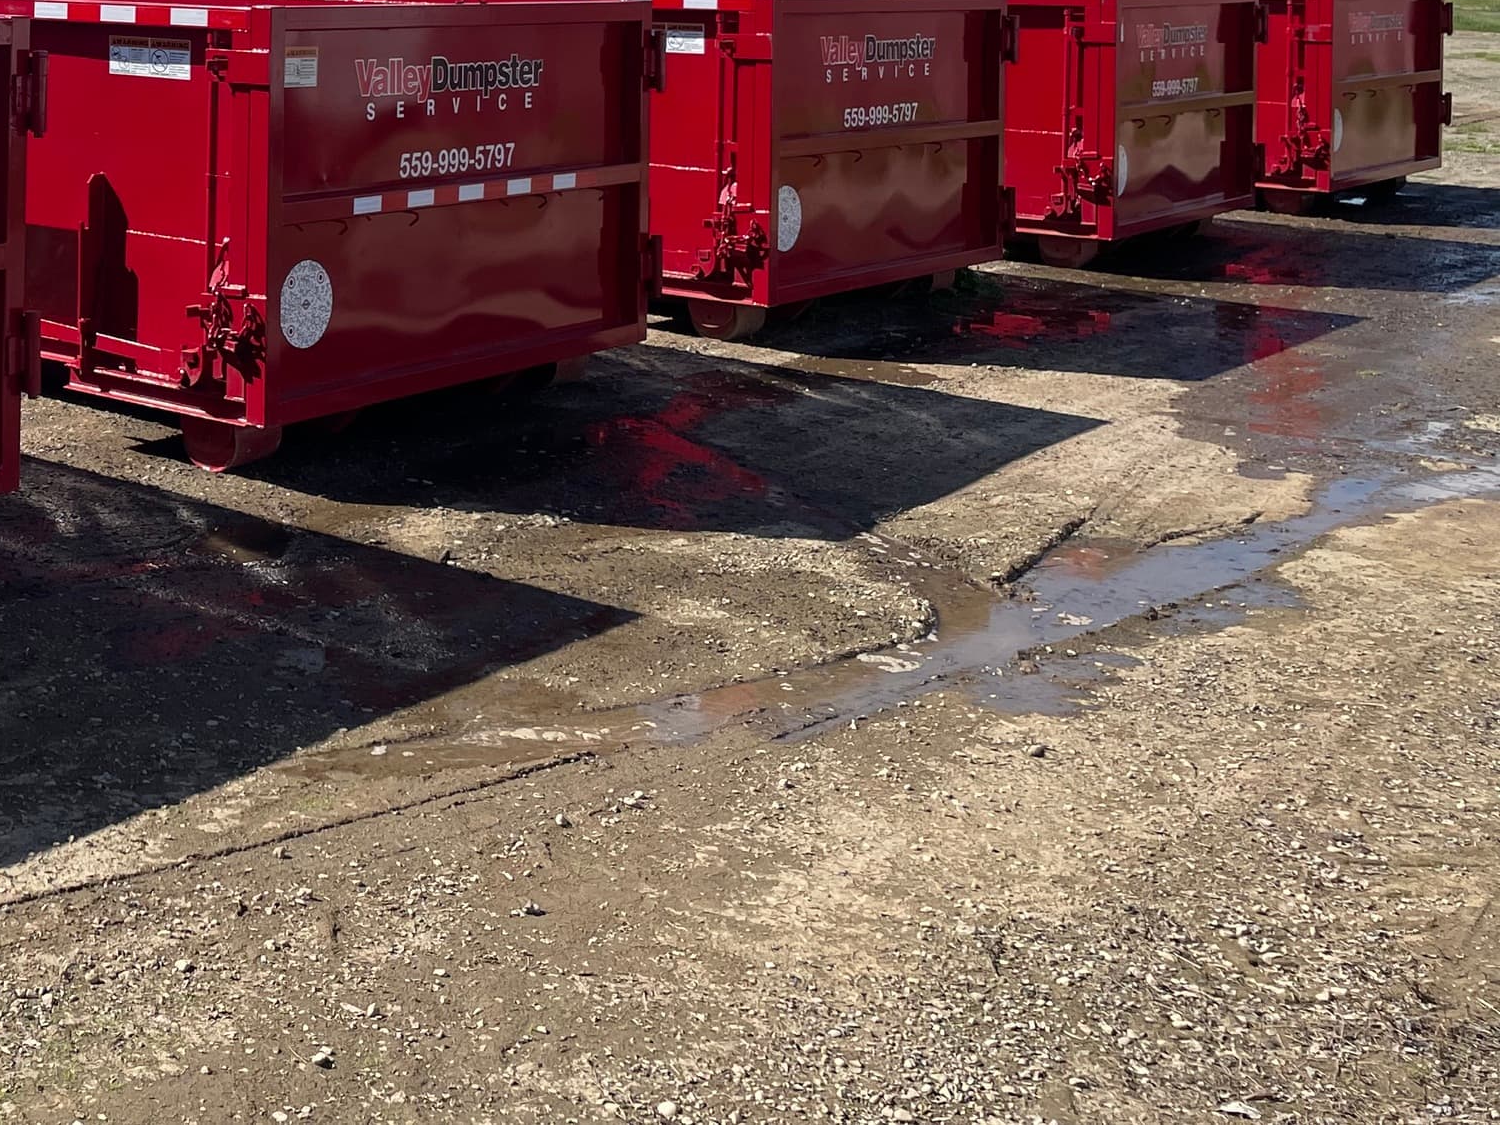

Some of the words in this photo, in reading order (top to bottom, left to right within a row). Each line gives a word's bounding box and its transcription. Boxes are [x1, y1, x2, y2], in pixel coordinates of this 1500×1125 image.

[820, 33, 936, 71] ValleyDumpster
[355, 54, 544, 104] ValleyDumpster
[826, 63, 930, 83] SERVICE
[366, 92, 533, 121] SERVICE
[843, 102, 918, 128] 559-999-5797
[400, 142, 516, 179] 559-999-5797
